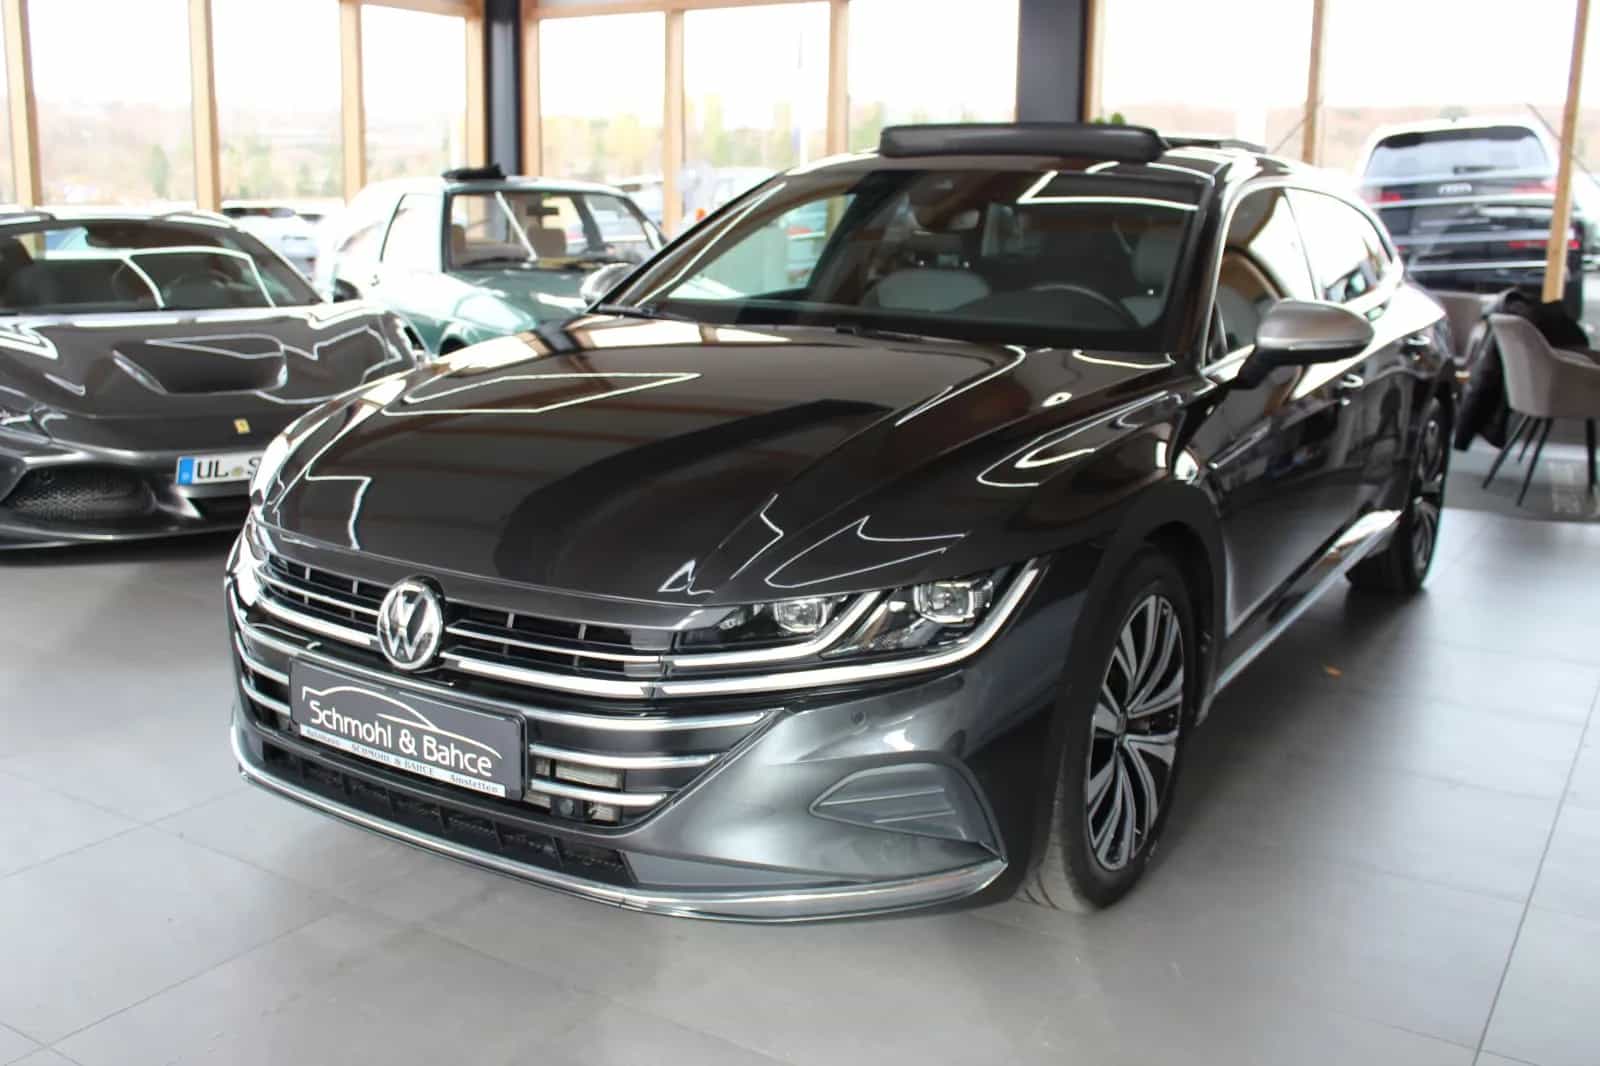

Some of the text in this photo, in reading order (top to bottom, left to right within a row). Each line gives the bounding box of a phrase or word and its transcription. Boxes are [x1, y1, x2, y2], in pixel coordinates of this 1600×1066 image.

[197, 460, 229, 479] UL
[309, 700, 392, 749] Schmohl
[399, 728, 418, 756] &
[423, 734, 492, 777] Bahce
